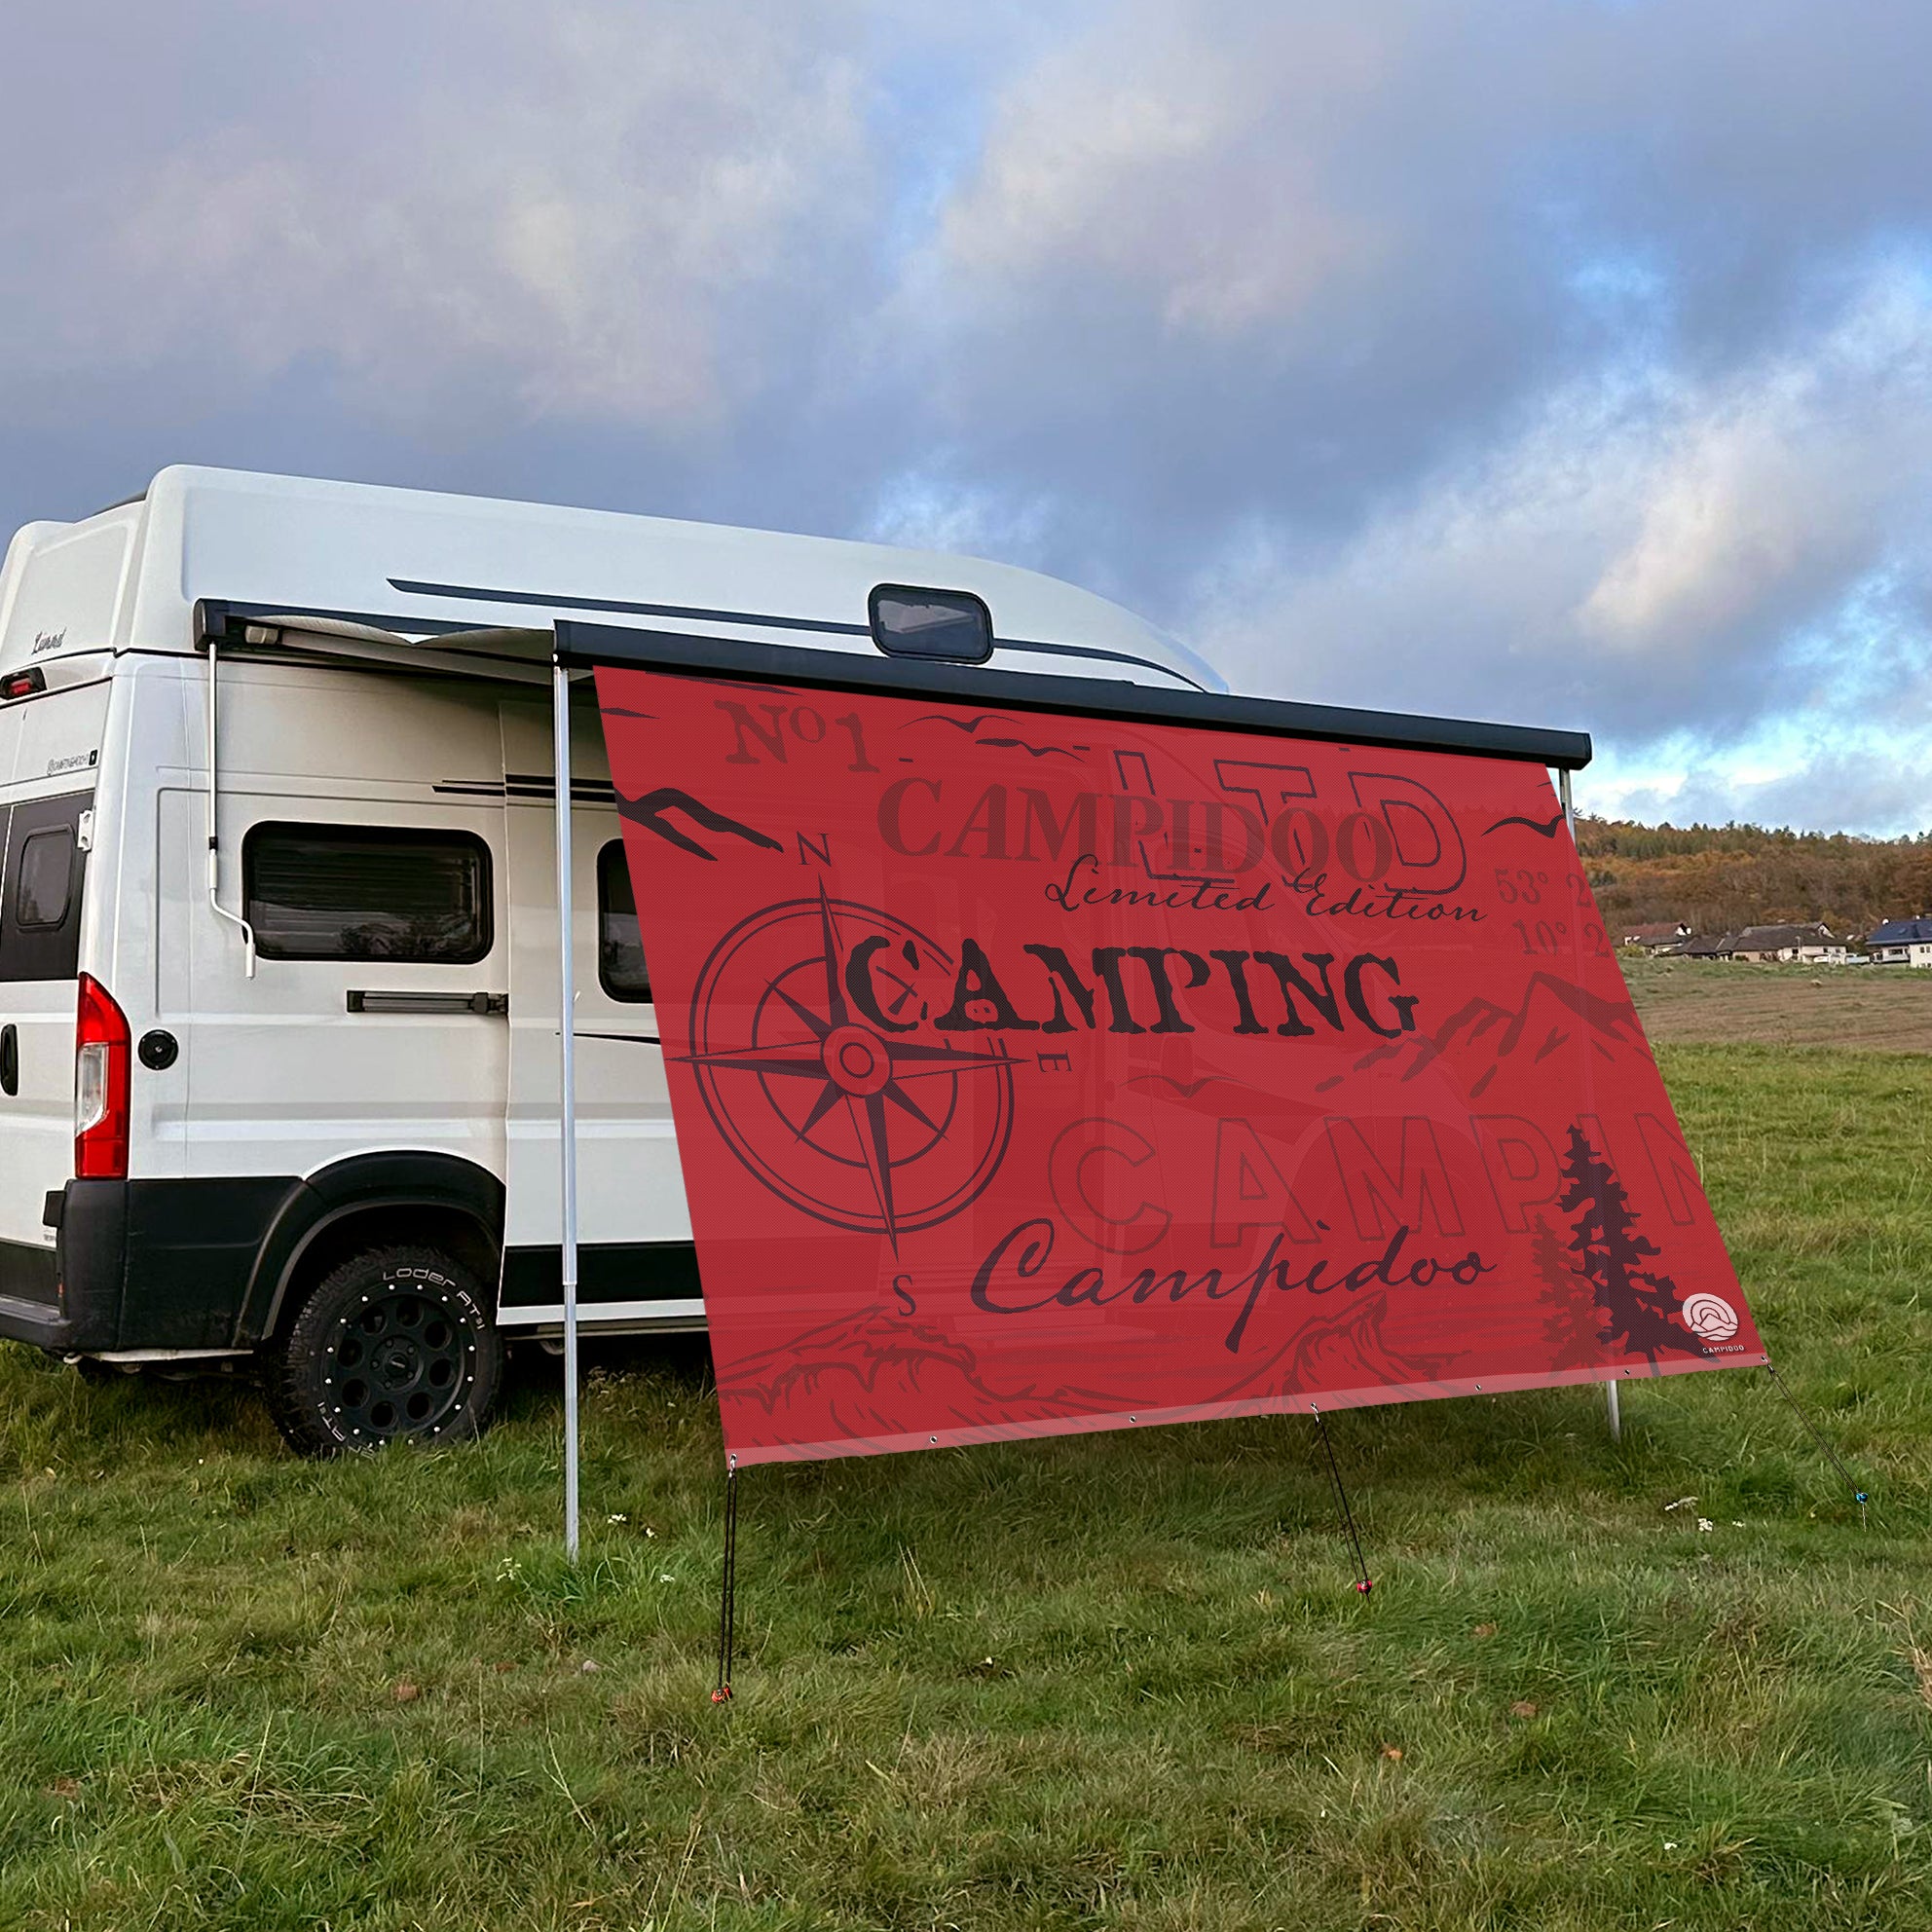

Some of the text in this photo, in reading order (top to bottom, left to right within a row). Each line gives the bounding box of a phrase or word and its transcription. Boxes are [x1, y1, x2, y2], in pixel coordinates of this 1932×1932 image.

[797, 831, 832, 867] N
[877, 777, 1393, 882] CAMPIDOO
[1045, 853, 1488, 922] Limited Edition
[845, 935, 1420, 1039] CAMPING
[892, 1274, 916, 1317] S
[970, 1218, 1498, 1355] Campidoo
[1702, 1345, 1745, 1355] CAMPIDOO
